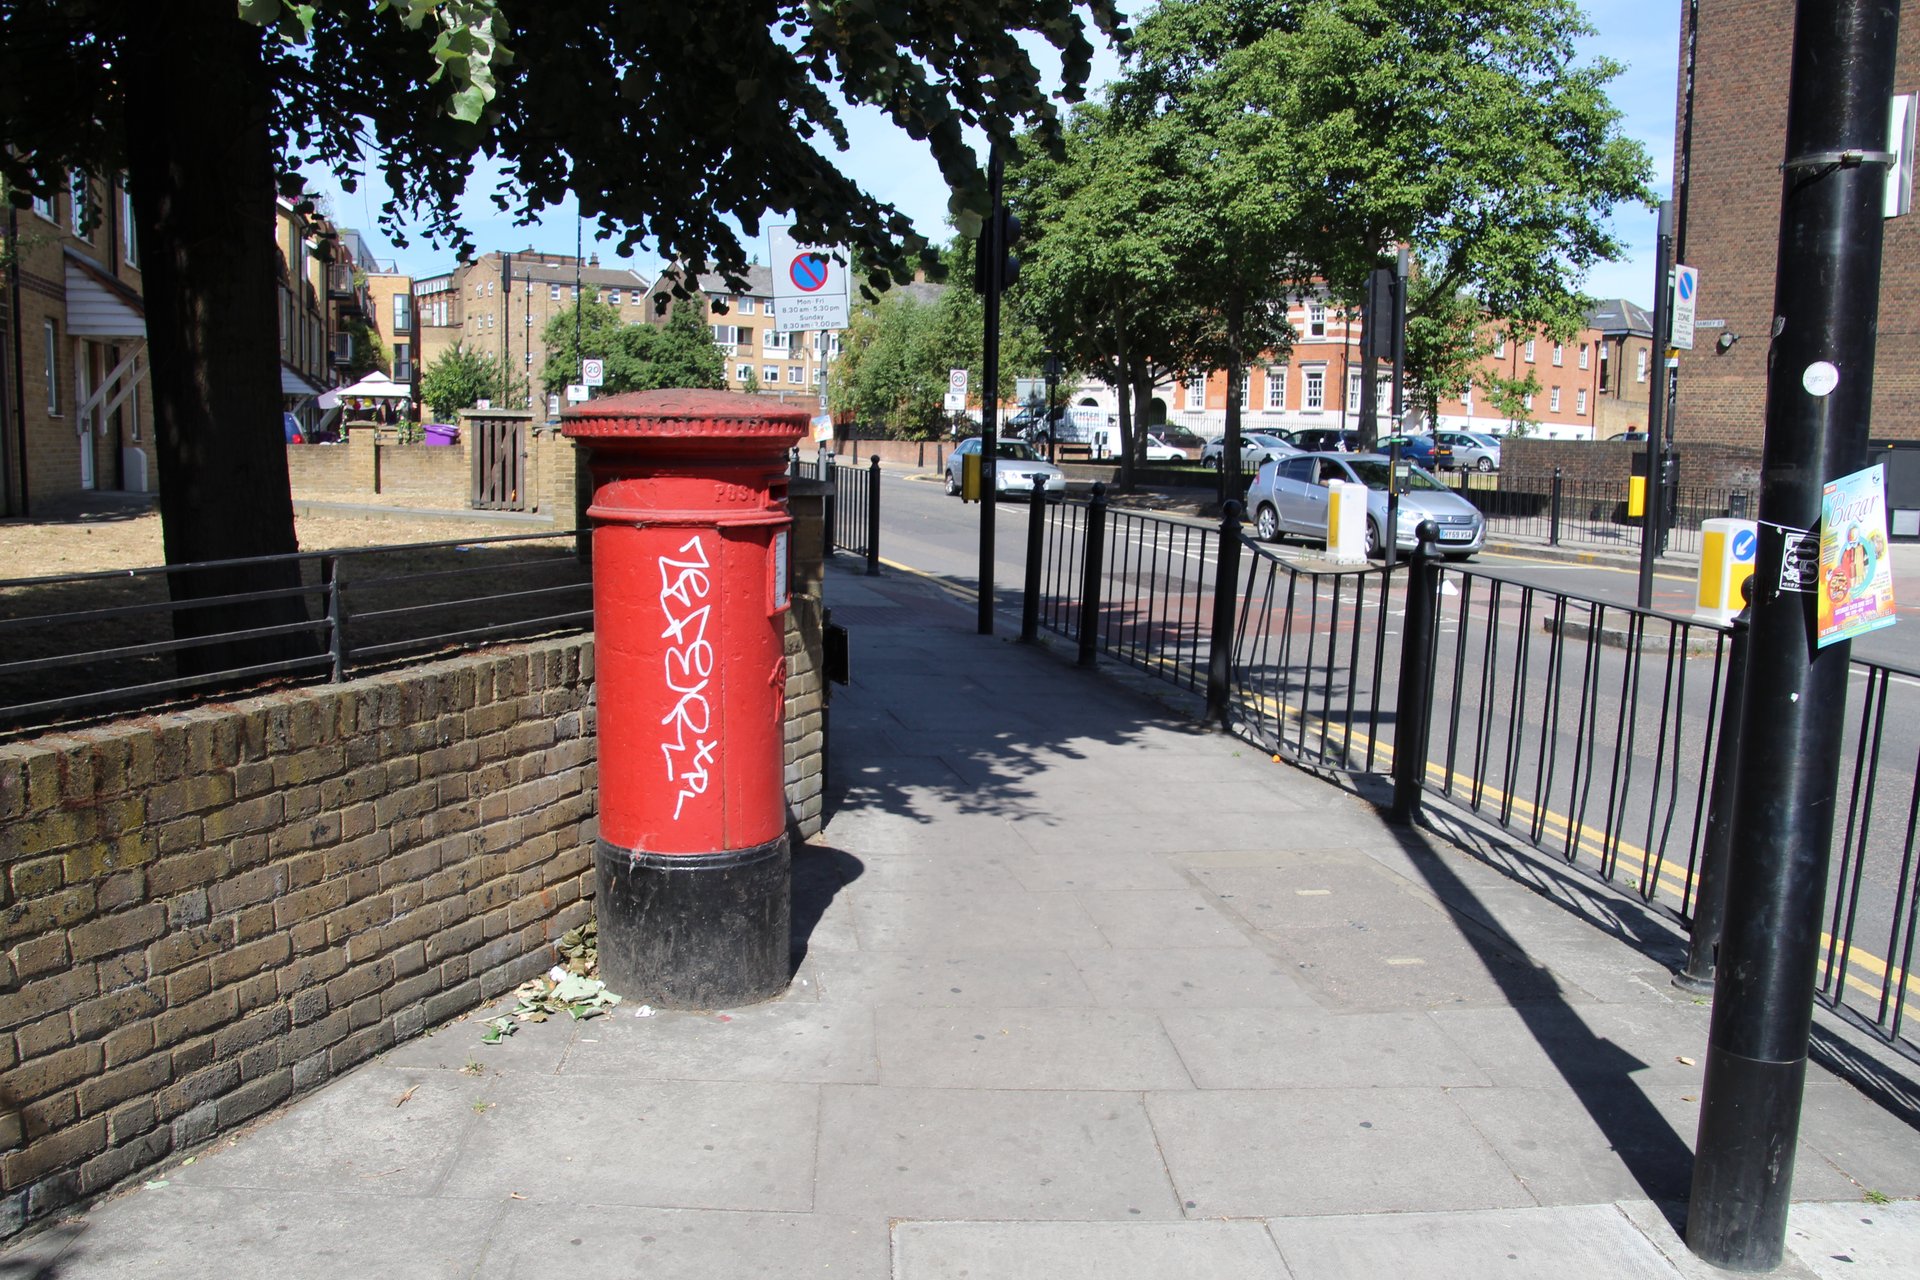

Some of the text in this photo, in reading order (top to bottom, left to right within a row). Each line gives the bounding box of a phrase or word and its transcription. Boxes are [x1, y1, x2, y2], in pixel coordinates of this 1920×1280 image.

[782, 306, 798, 314] 8.30
[799, 314, 825, 322] Sunday
[1678, 312, 1690, 322] ZONE
[783, 322, 799, 330] 8.30
[587, 366, 599, 374] 20
[954, 375, 964, 383] 20
[1829, 492, 1880, 528] Bazar
